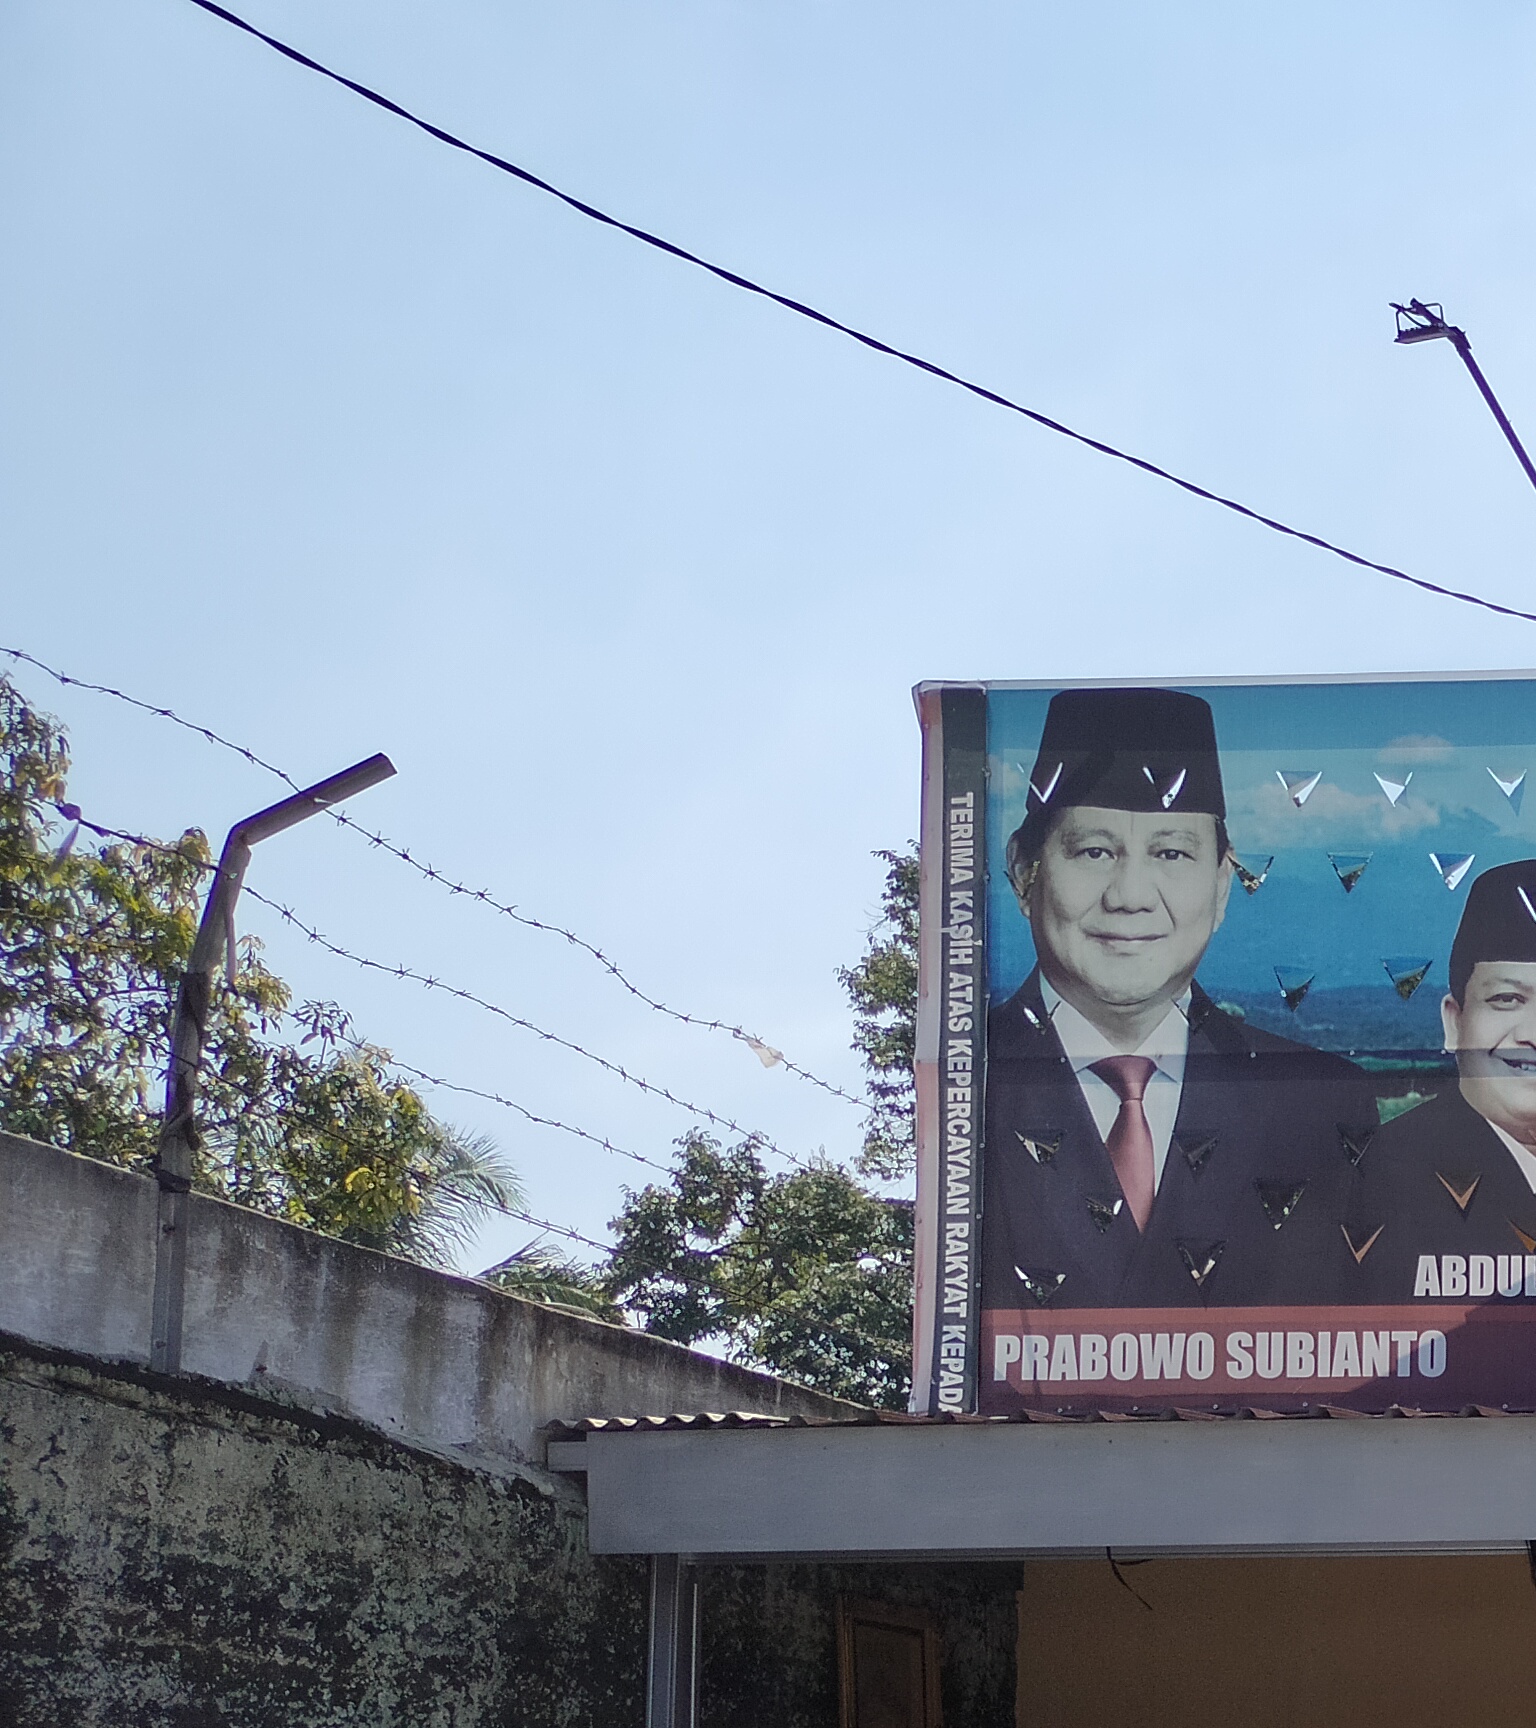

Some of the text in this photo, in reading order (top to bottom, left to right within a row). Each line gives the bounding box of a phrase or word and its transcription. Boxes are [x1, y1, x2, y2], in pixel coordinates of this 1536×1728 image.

[950, 791, 974, 885] TERIMA
[949, 891, 974, 965] KASIH
[948, 972, 973, 1032] ATAS
[946, 1039, 973, 1215] KEPERCAYAAN
[943, 1222, 969, 1318] RAKYAT
[993, 1329, 1447, 1382] PRABOWO SUBIANTO
